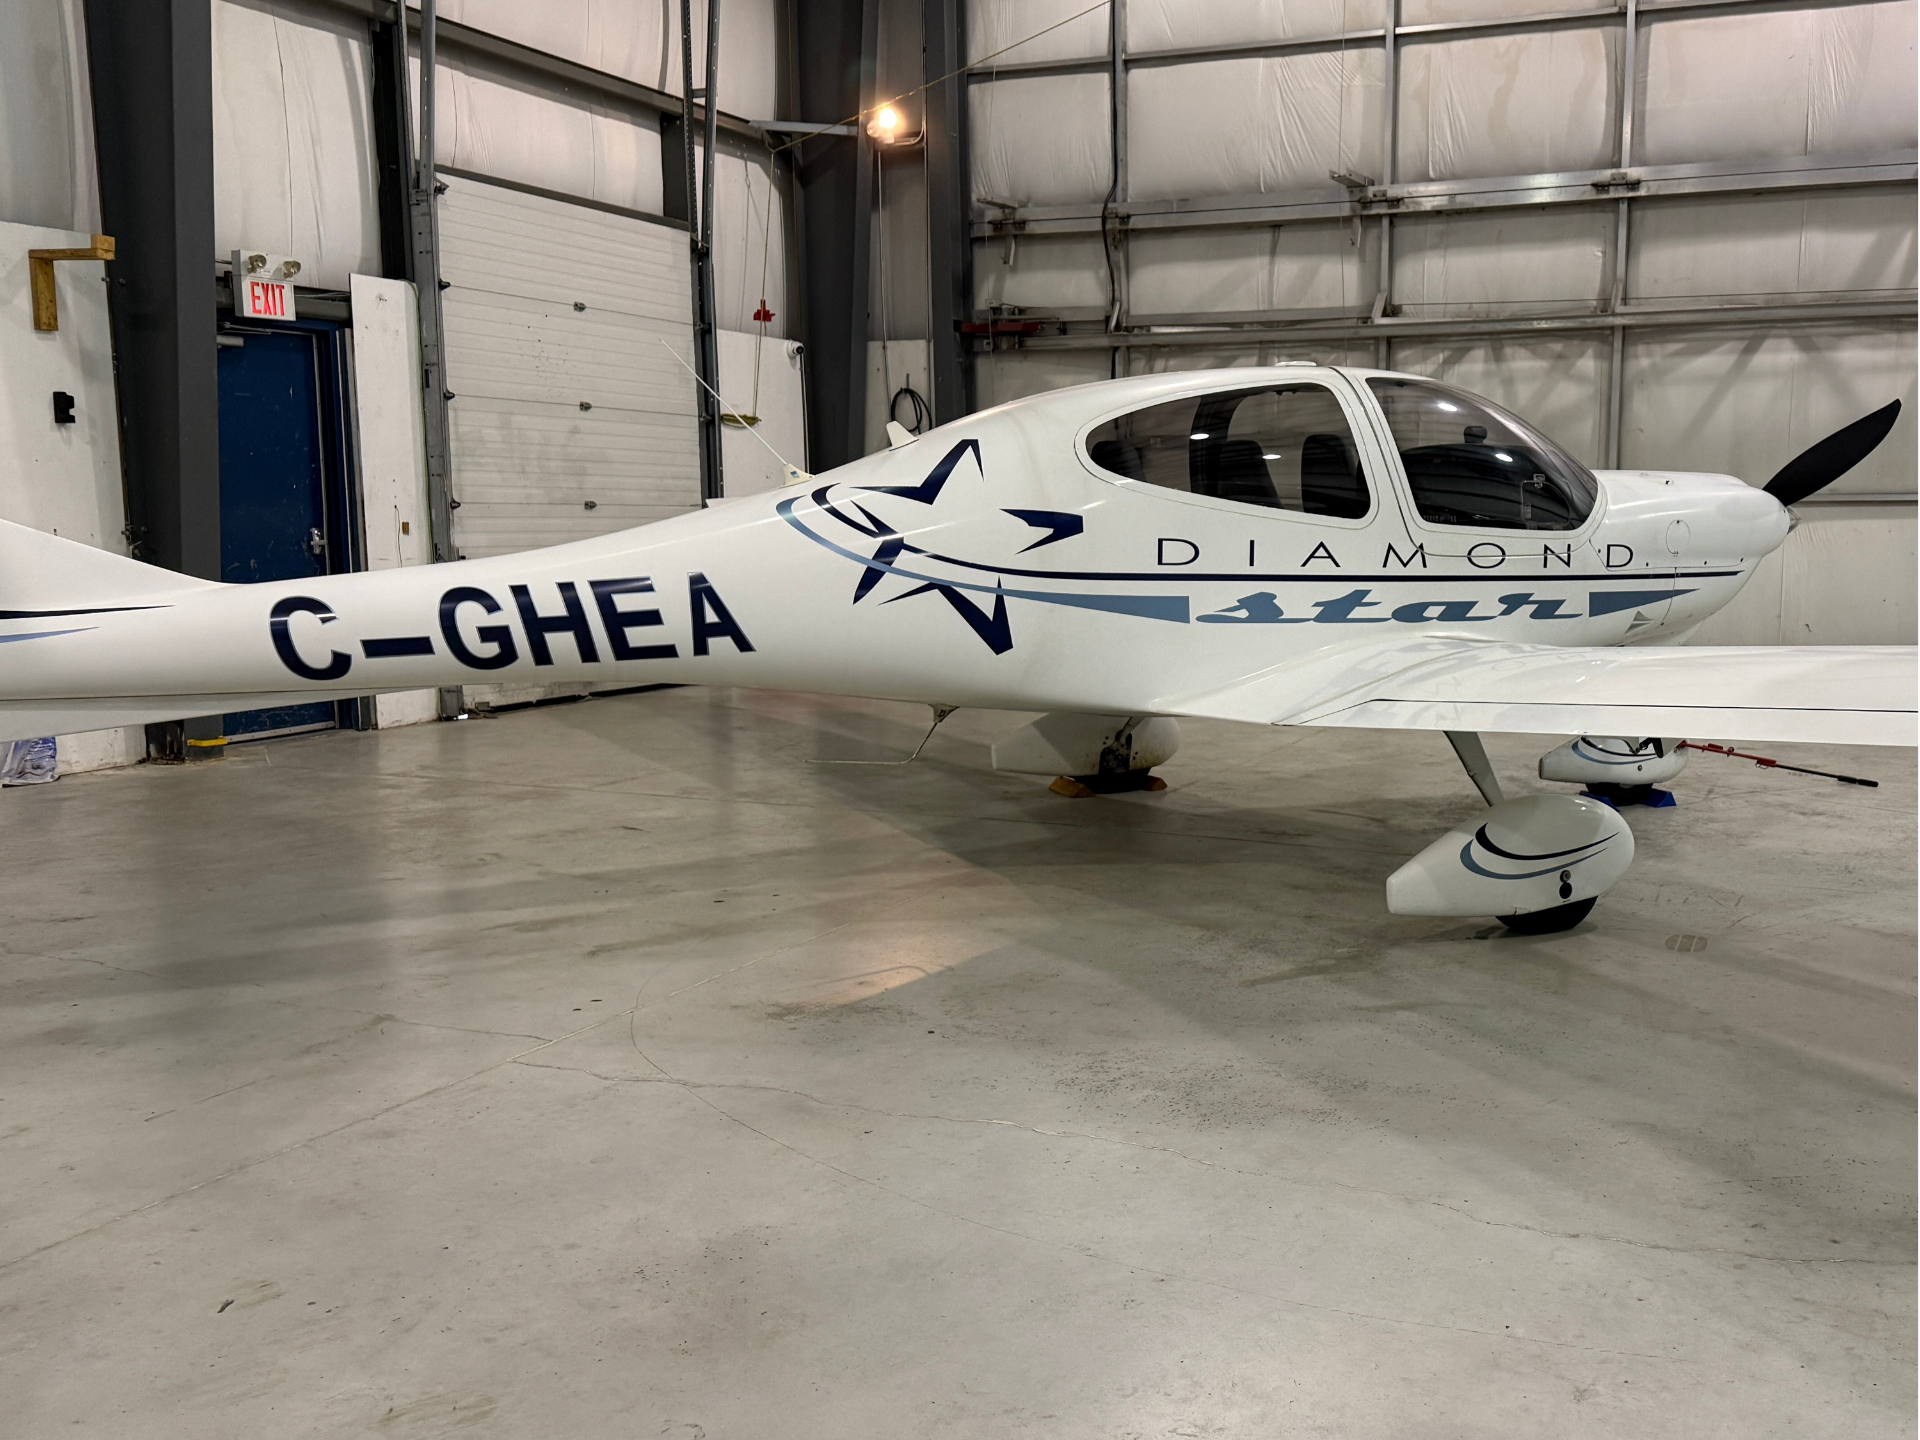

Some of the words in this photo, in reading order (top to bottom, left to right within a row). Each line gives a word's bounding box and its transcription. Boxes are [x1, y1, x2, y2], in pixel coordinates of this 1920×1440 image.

[250, 281, 285, 317] EXIT
[1157, 537, 1634, 569] DIAMOND
[1195, 589, 1584, 624] star
[269, 571, 757, 681] C-GHEA
